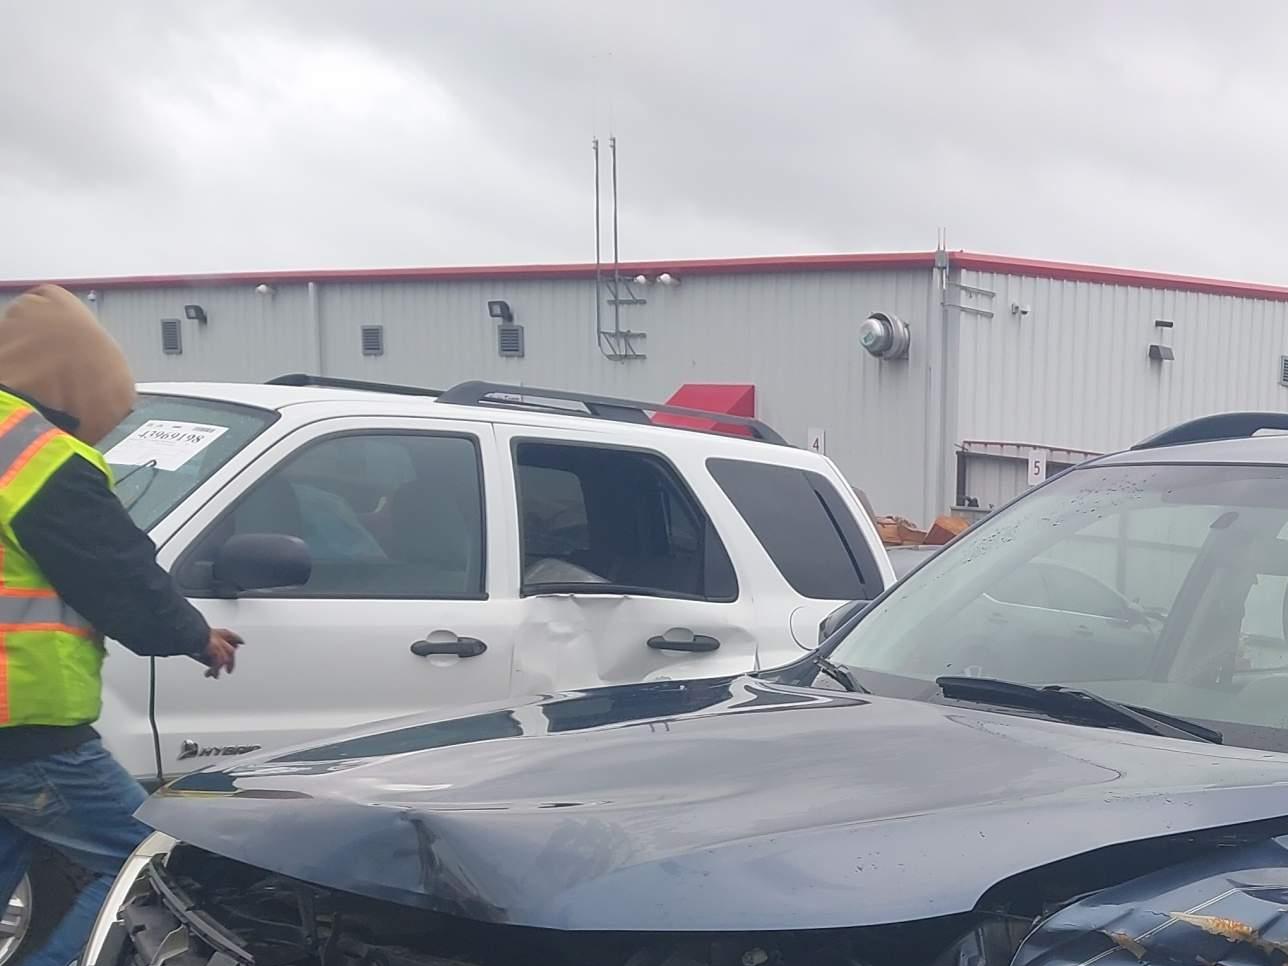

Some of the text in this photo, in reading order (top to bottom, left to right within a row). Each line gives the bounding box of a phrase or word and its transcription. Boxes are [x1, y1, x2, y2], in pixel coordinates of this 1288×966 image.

[138, 430, 205, 443] 43969198
[812, 437, 820, 450] 4
[1034, 460, 1041, 475] 5
